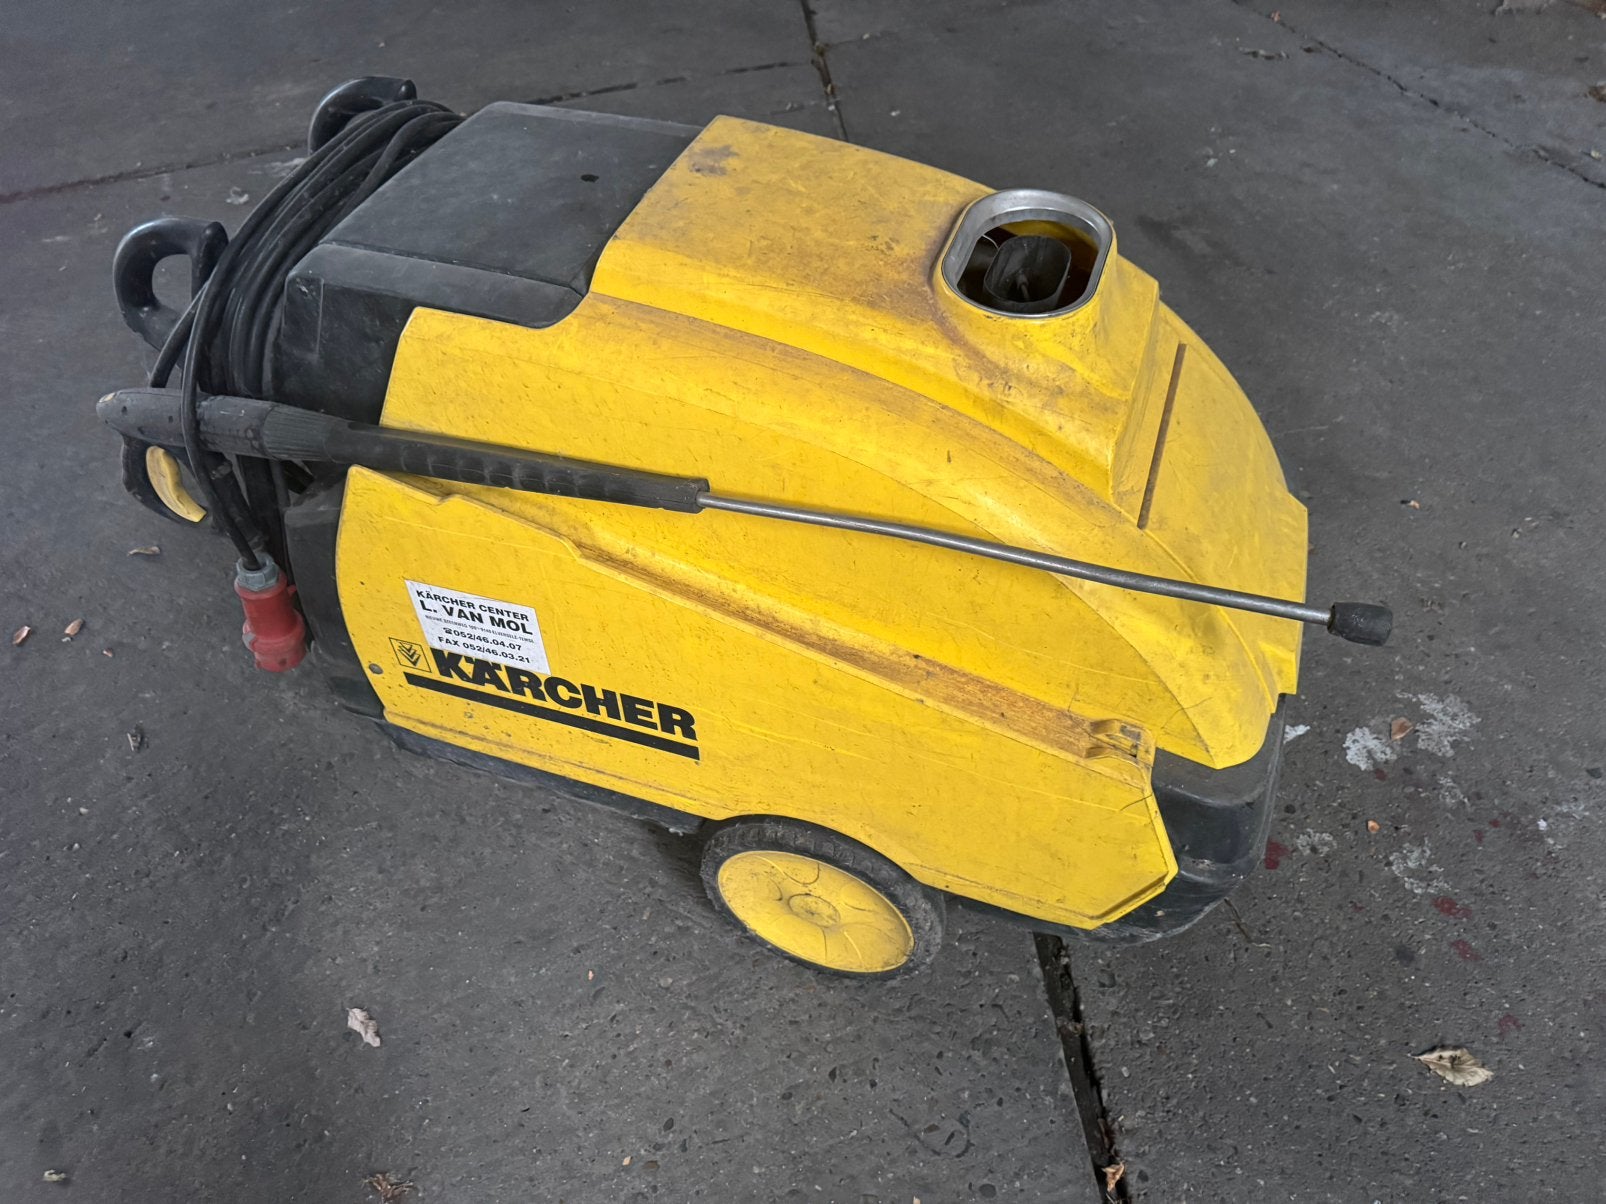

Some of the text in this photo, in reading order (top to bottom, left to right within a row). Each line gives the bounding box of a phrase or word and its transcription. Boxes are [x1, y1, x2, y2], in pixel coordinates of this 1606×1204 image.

[416, 589, 530, 622] KÄRCHER CENTER
[419, 599, 438, 614] L.
[442, 605, 484, 624] VAN
[490, 615, 534, 636] MOL
[437, 635, 531, 664] FAX 052/46.03.21
[430, 647, 698, 742] KÄRCHER
